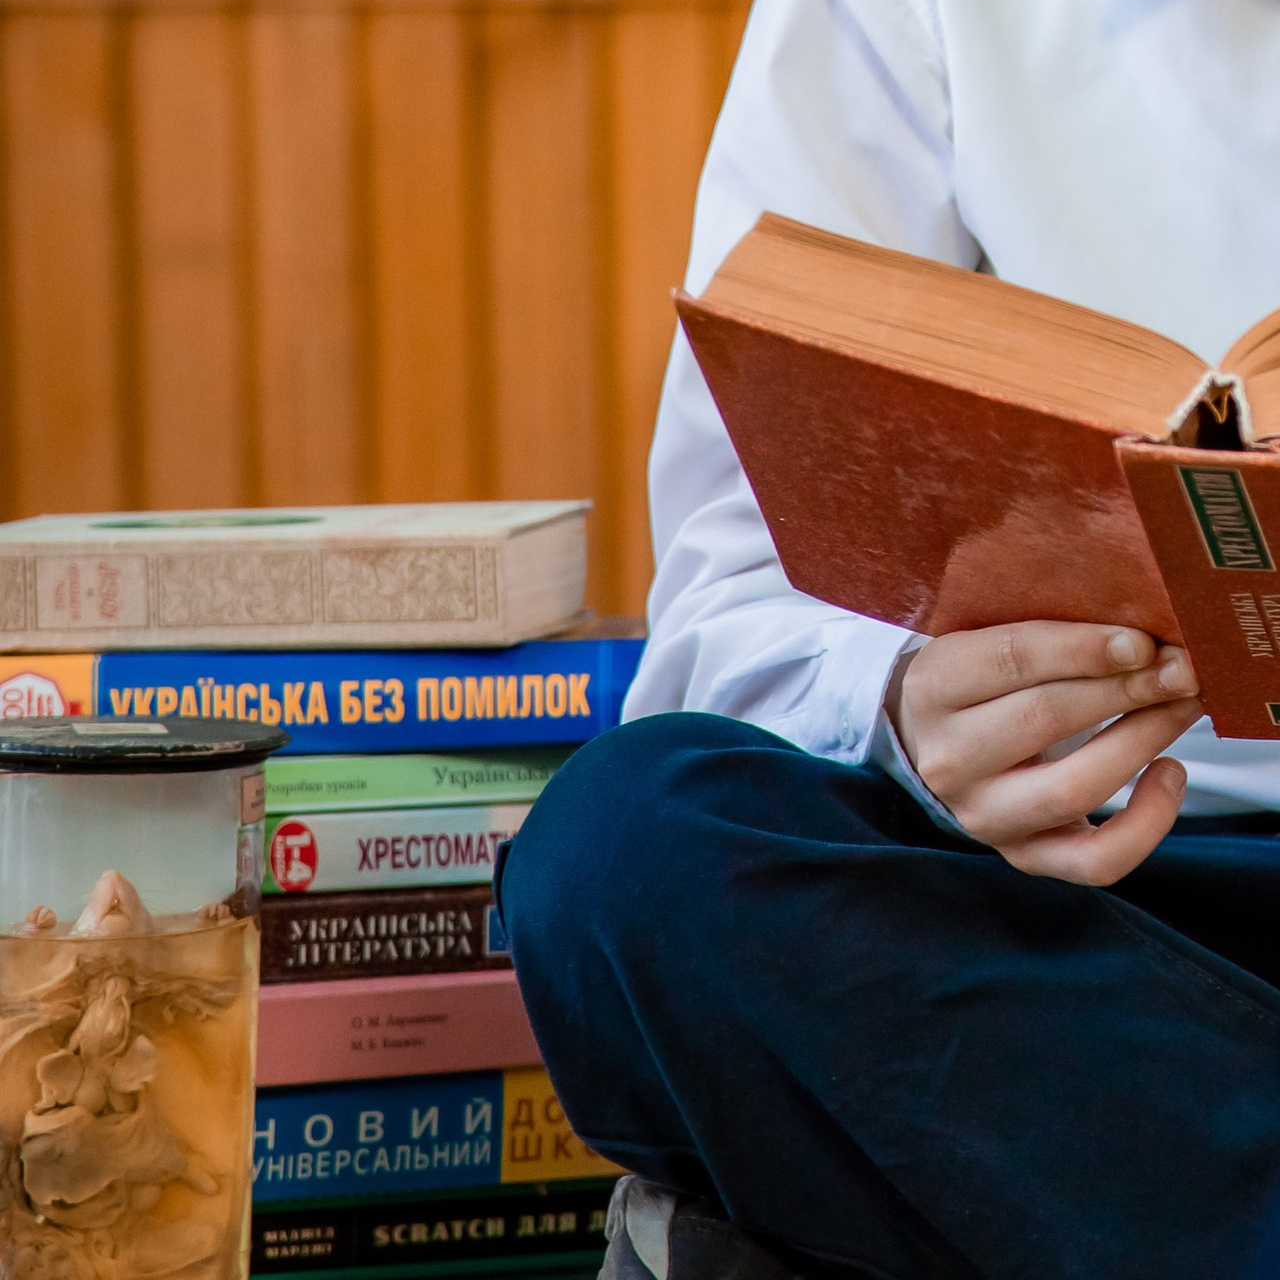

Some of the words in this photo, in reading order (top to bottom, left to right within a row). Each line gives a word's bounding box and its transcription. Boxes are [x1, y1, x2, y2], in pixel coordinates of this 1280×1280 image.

[109, 676, 330, 726] УКРАЇНСЬКА
[340, 677, 406, 723] БЕЗ
[416, 672, 592, 721] ПОМИЛОК
[357, 829, 518, 871] ХРЕСТОМАТ
[286, 934, 473, 968] ЛІТЕРАТУРА
[253, 1097, 493, 1150] НОВИЙ
[509, 1130, 600, 1163] ШК
[372, 1217, 505, 1247] SCRATCH
